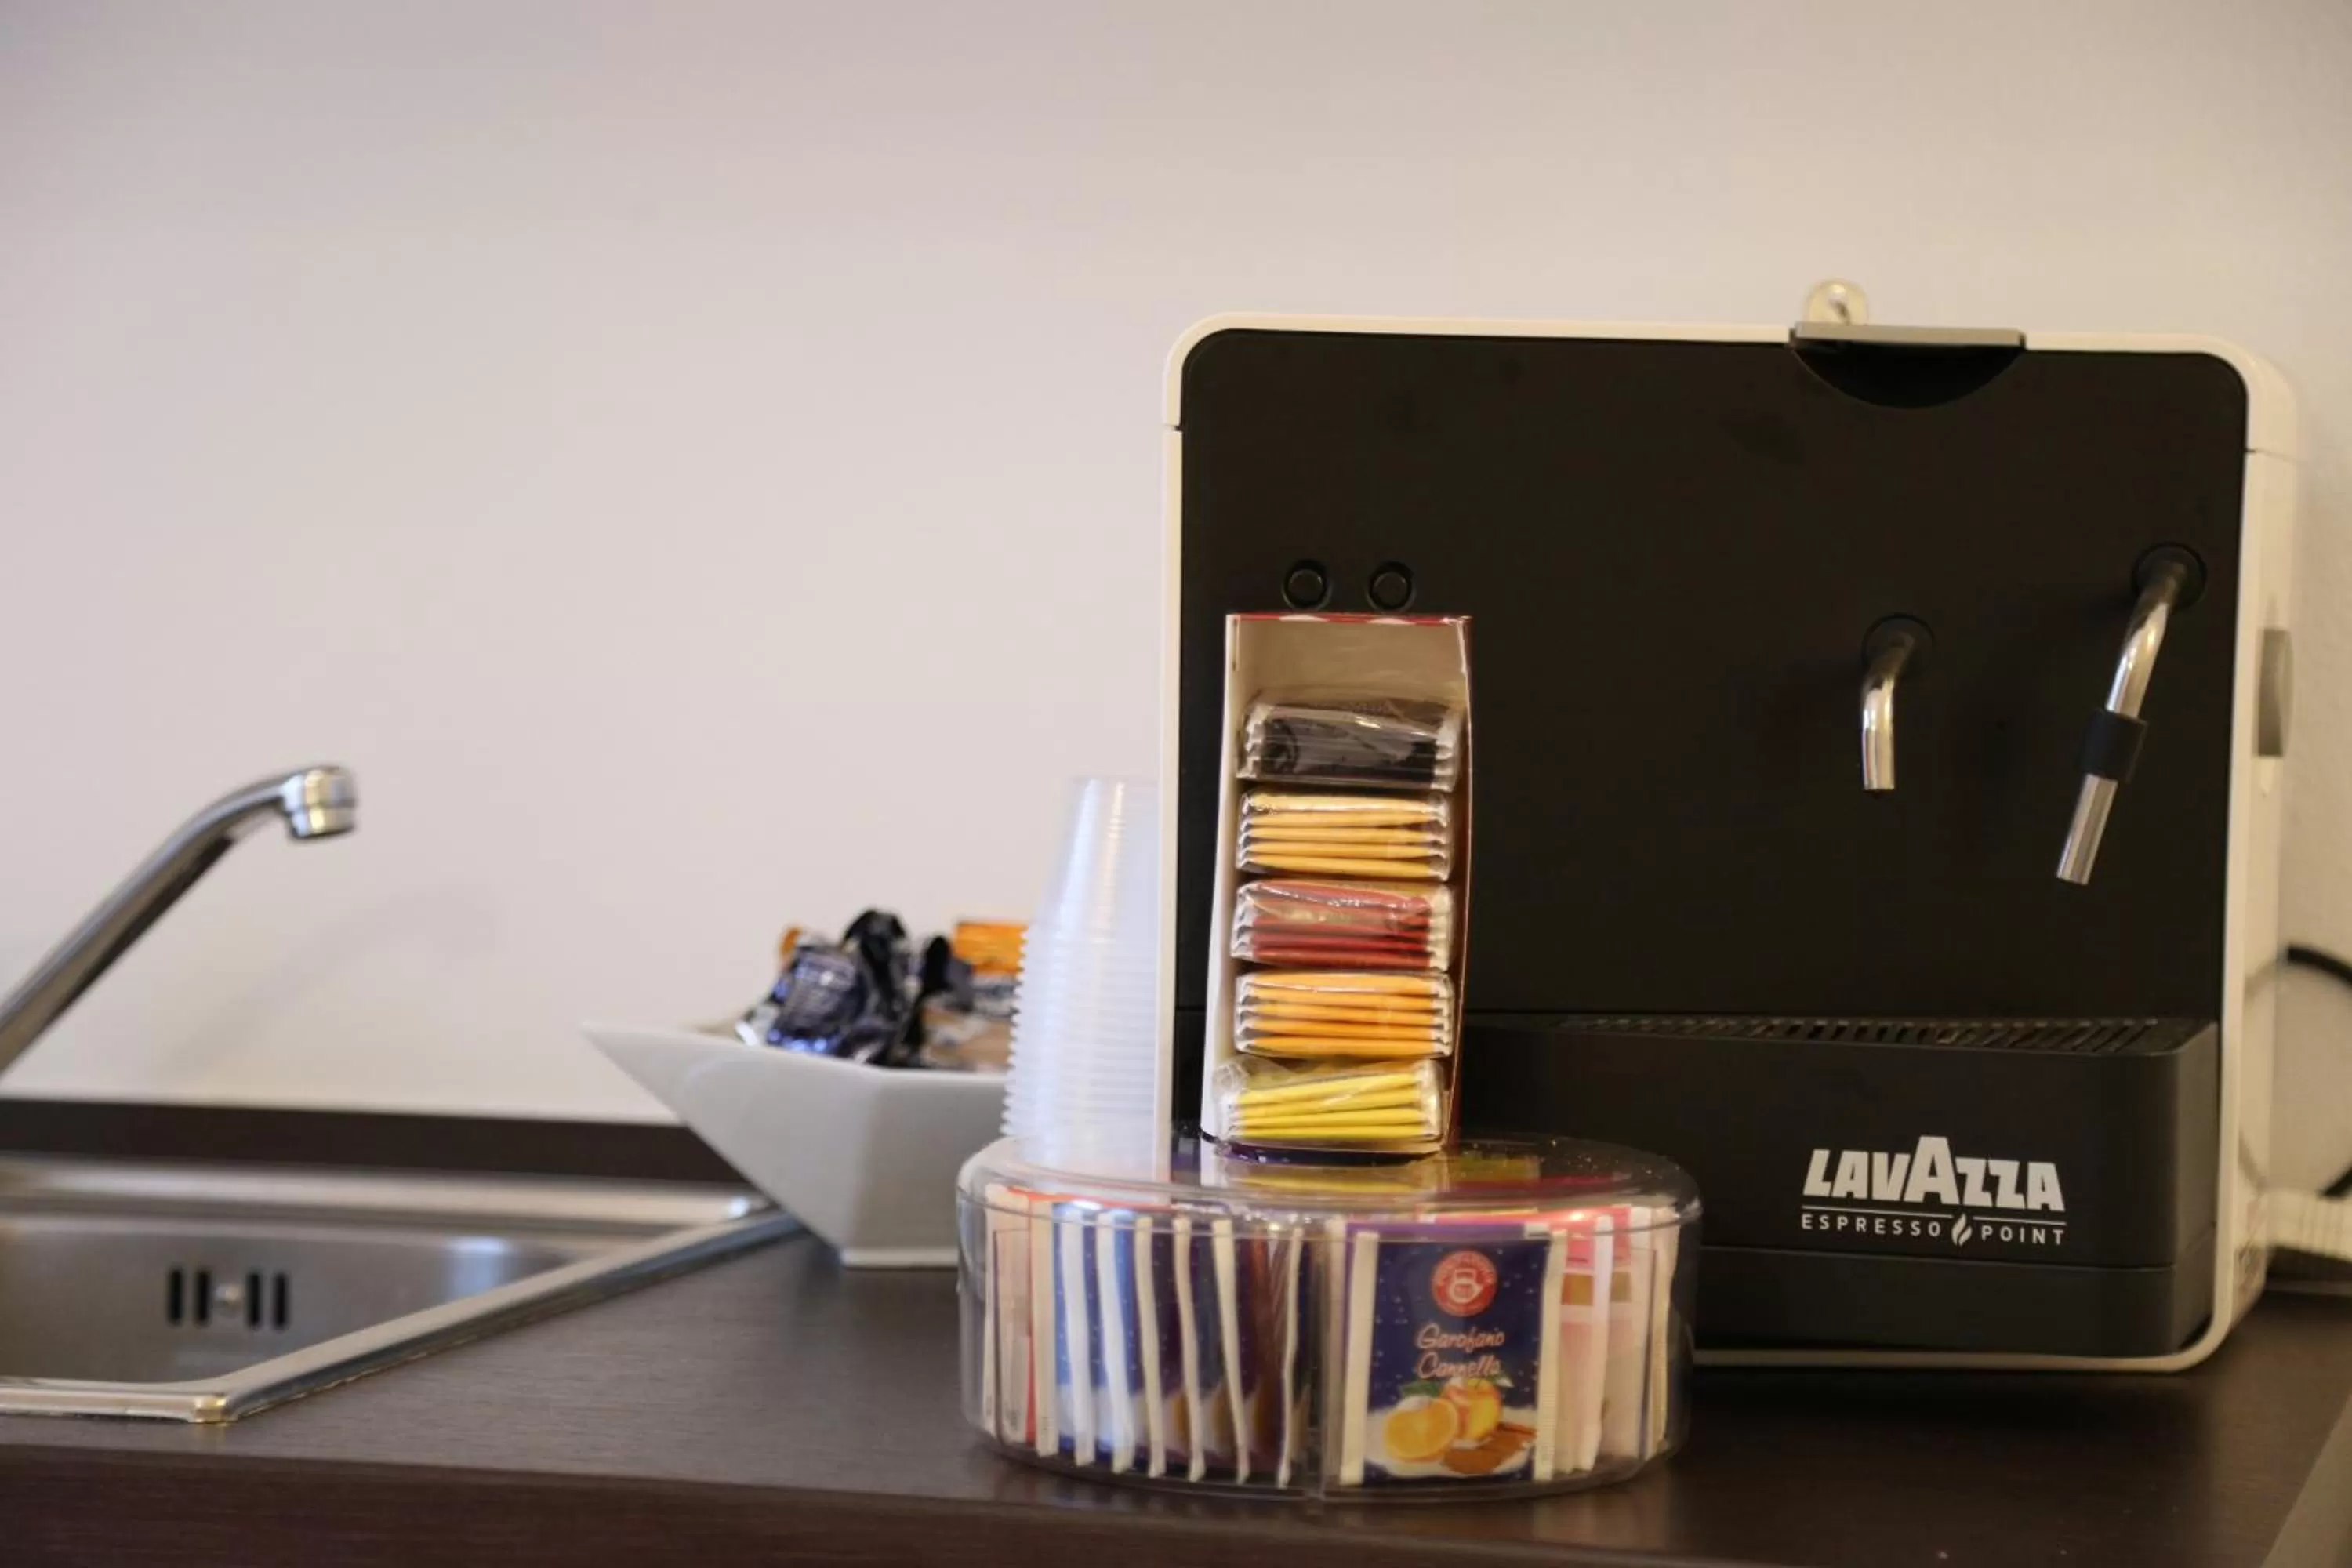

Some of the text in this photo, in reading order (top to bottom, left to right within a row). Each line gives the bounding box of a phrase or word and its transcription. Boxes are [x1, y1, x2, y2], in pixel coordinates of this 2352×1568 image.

[1803, 1135, 2066, 1212] LAVAZZA
[1802, 1213, 2065, 1246] ESPRESSO POINT
